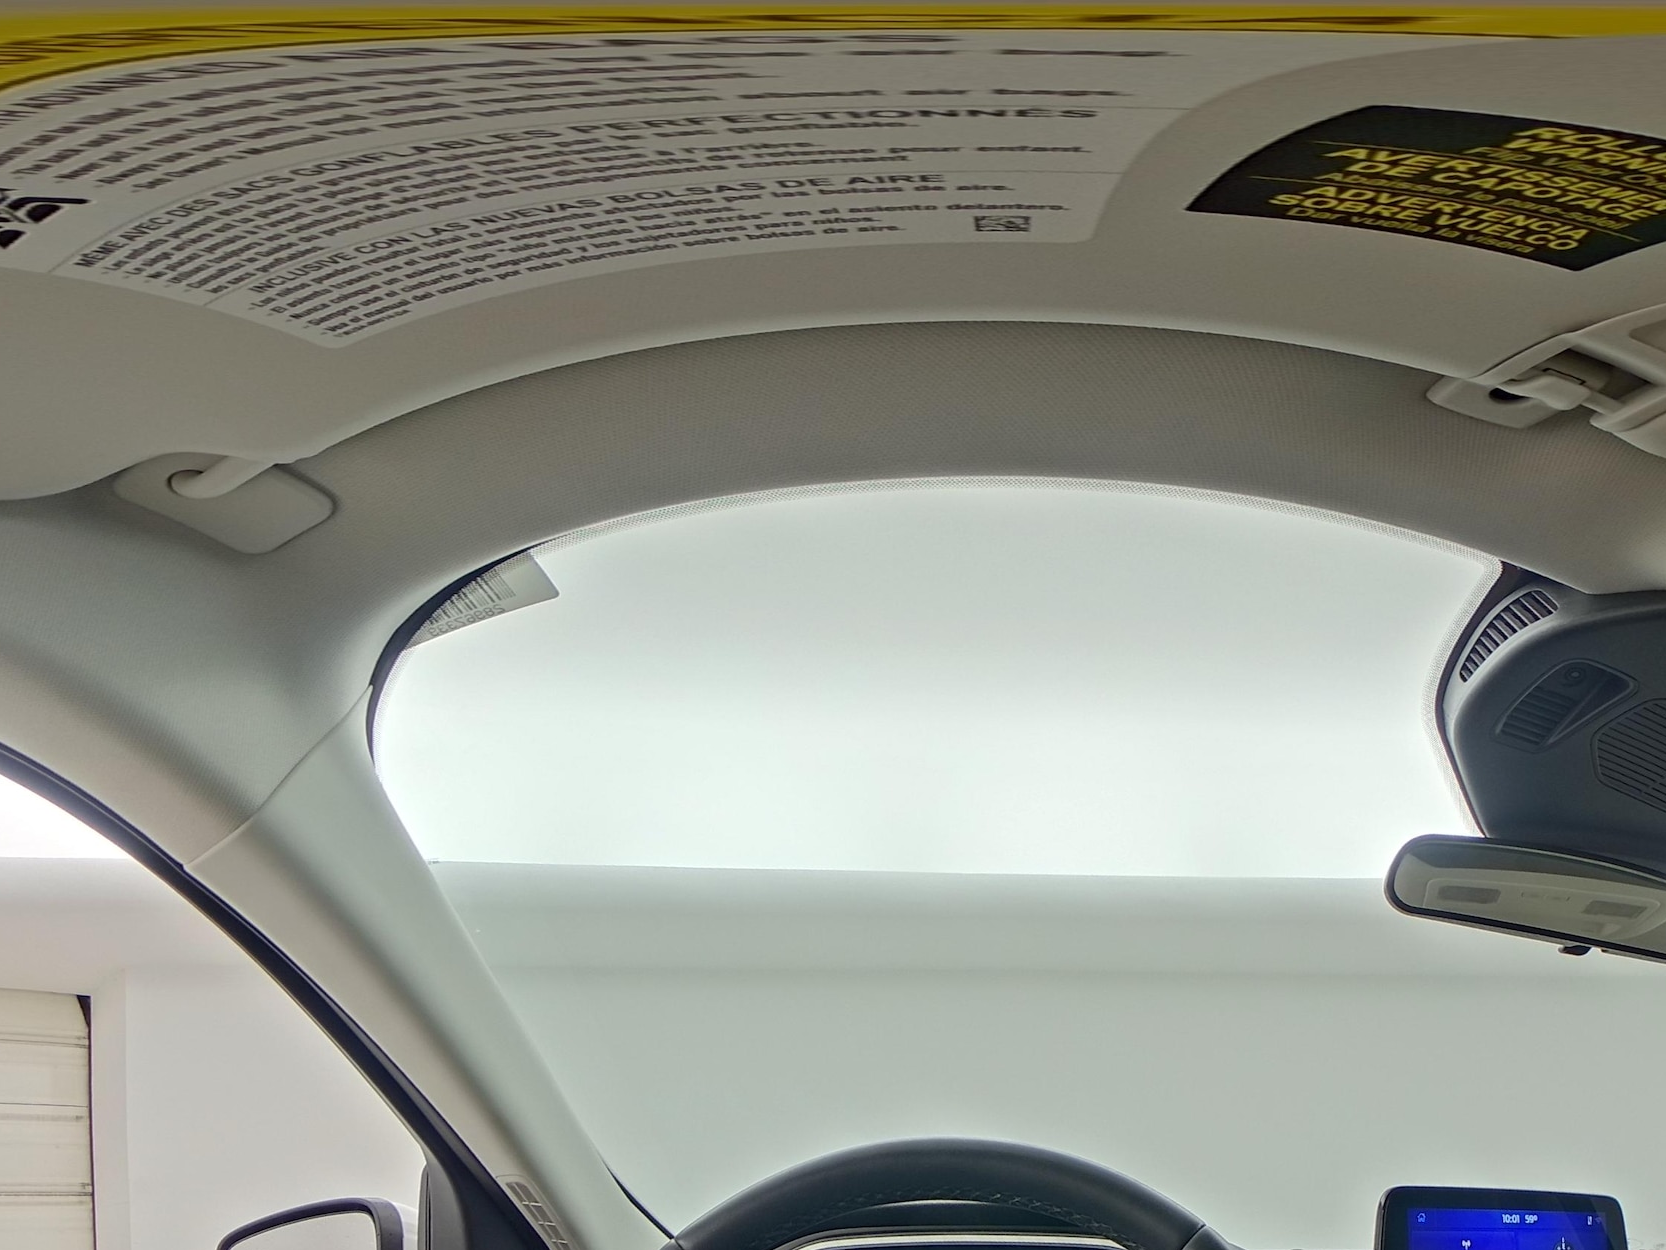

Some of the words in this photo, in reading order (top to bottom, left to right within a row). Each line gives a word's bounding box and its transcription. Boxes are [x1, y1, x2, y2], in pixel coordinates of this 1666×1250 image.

[73, 240, 130, 268] MÊME
[118, 217, 175, 242] AVEC
[164, 198, 221, 218] DES
[211, 175, 296, 200] SACS
[289, 129, 563, 177] GONFLABLES
[566, 108, 1097, 134] PERFECTIONNÉS
[1463, 146, 1536, 161] Flip
[1541, 157, 1623, 176] Visor
[1301, 186, 1589, 240] ADVERTENCIA
[1345, 161, 1429, 178] DE
[1431, 172, 1658, 221] CAPOTAGE
[248, 252, 358, 293] INCLUSIVE
[353, 236, 413, 254] CON
[410, 222, 471, 239] LAS
[469, 199, 604, 226] NUEVAS
[605, 182, 767, 204] BOLSAS
[774, 178, 835, 189] DE
[846, 174, 944, 185] AIRE
[1269, 194, 1432, 221] SOBRE
[1435, 214, 1579, 250] VUELCO
[1501, 1213, 1521, 1224] 10:01
